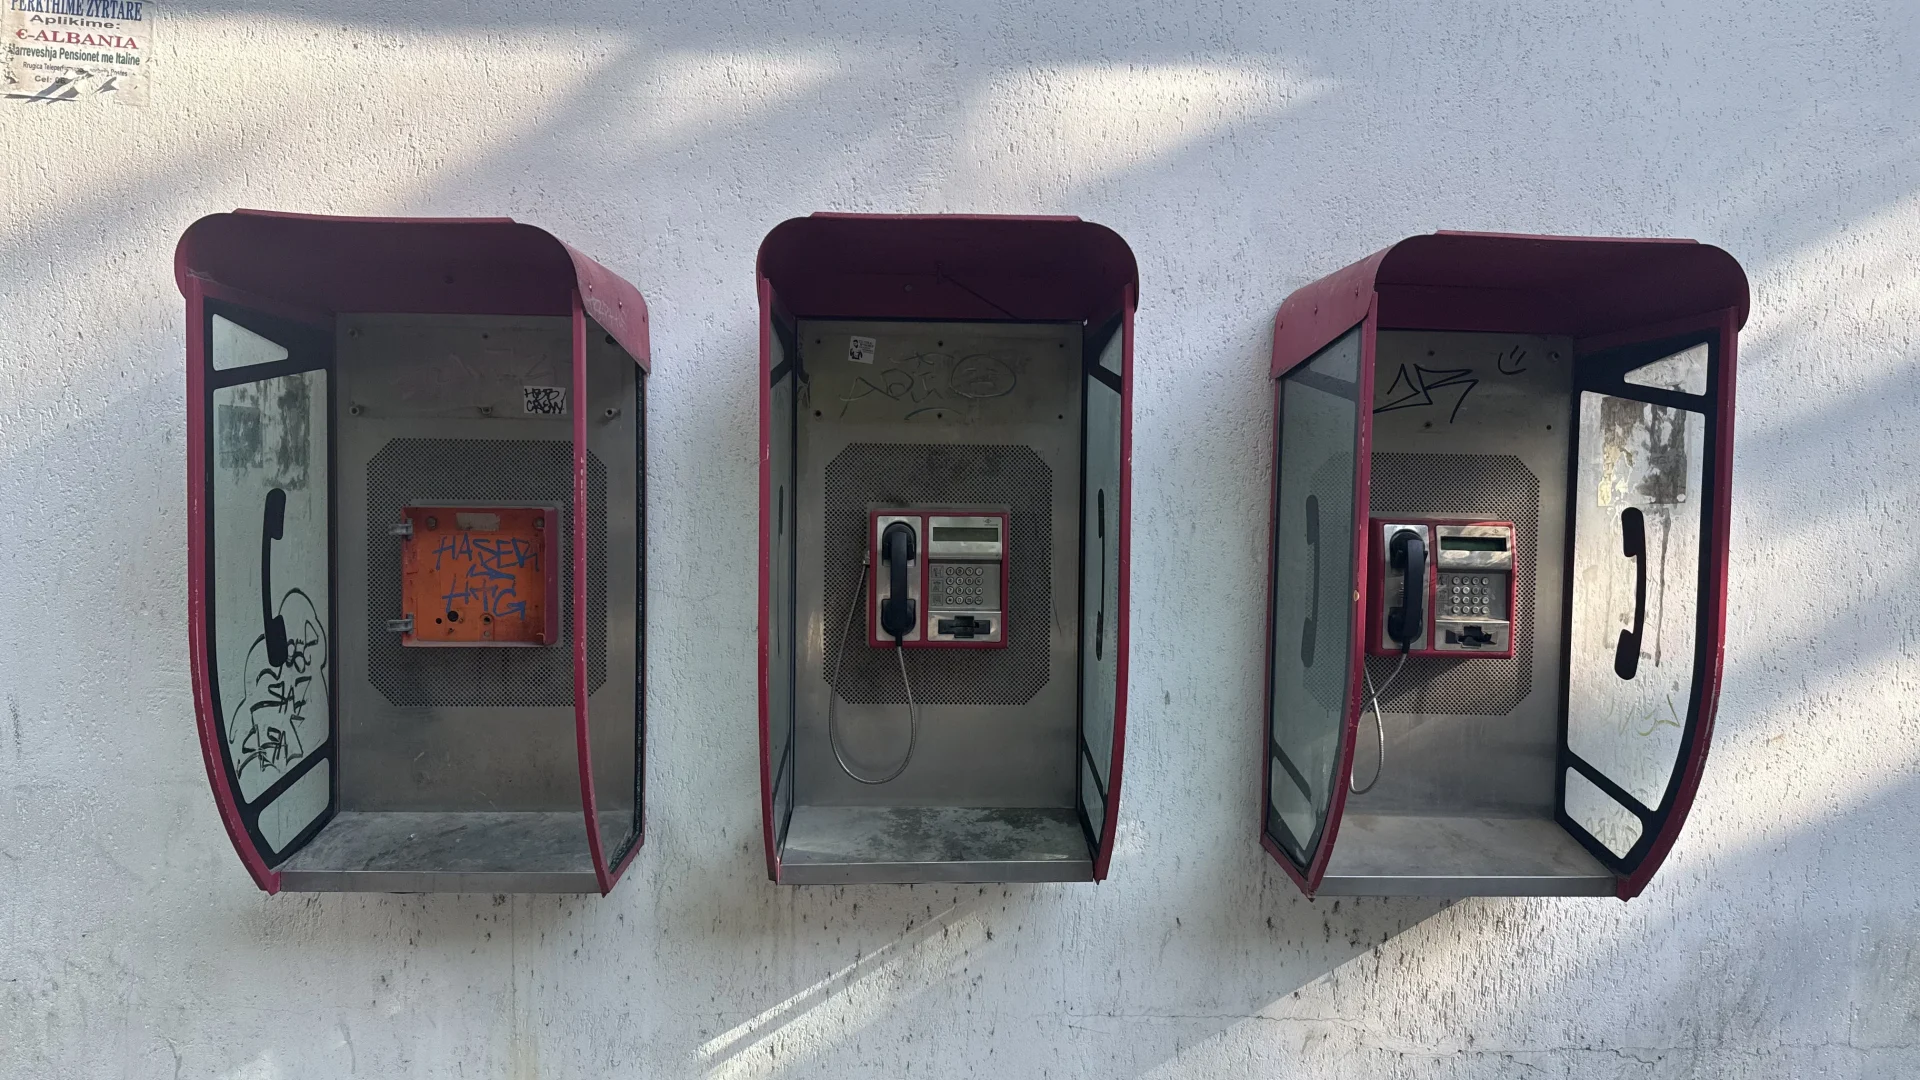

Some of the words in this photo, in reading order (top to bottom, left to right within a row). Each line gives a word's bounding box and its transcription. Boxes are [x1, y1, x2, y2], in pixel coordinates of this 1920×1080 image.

[86, 0, 142, 21] ZYRTARE
[30, 14, 120, 29] Aplikime:
[59, 47, 100, 62] Pensionet
[101, 53, 114, 63] me
[115, 52, 140, 65] Italine
[22, 61, 43, 70] Rrugica
[34, 75, 52, 83] Cel:
